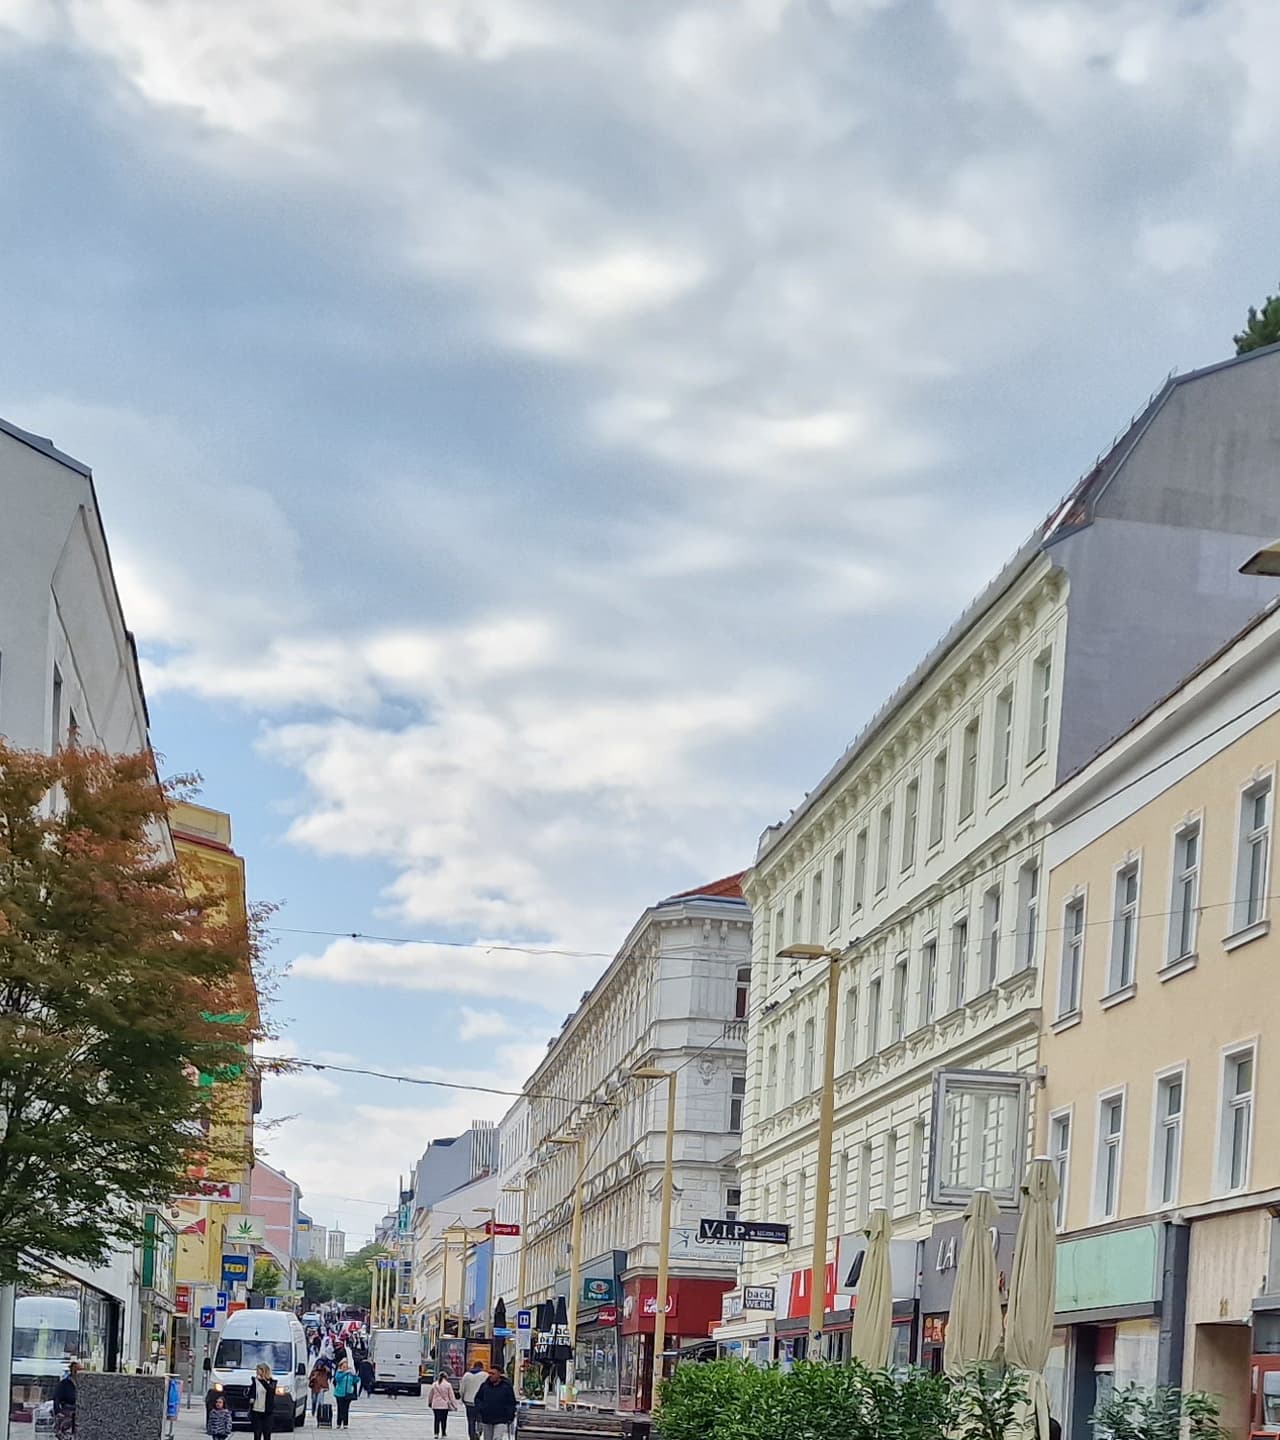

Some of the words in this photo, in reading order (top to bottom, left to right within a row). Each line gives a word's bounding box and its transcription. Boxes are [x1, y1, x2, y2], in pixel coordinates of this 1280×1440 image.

[704, 1222, 749, 1239] V.I.P.
[747, 1288, 771, 1300] back
[745, 1301, 773, 1310] WERK
